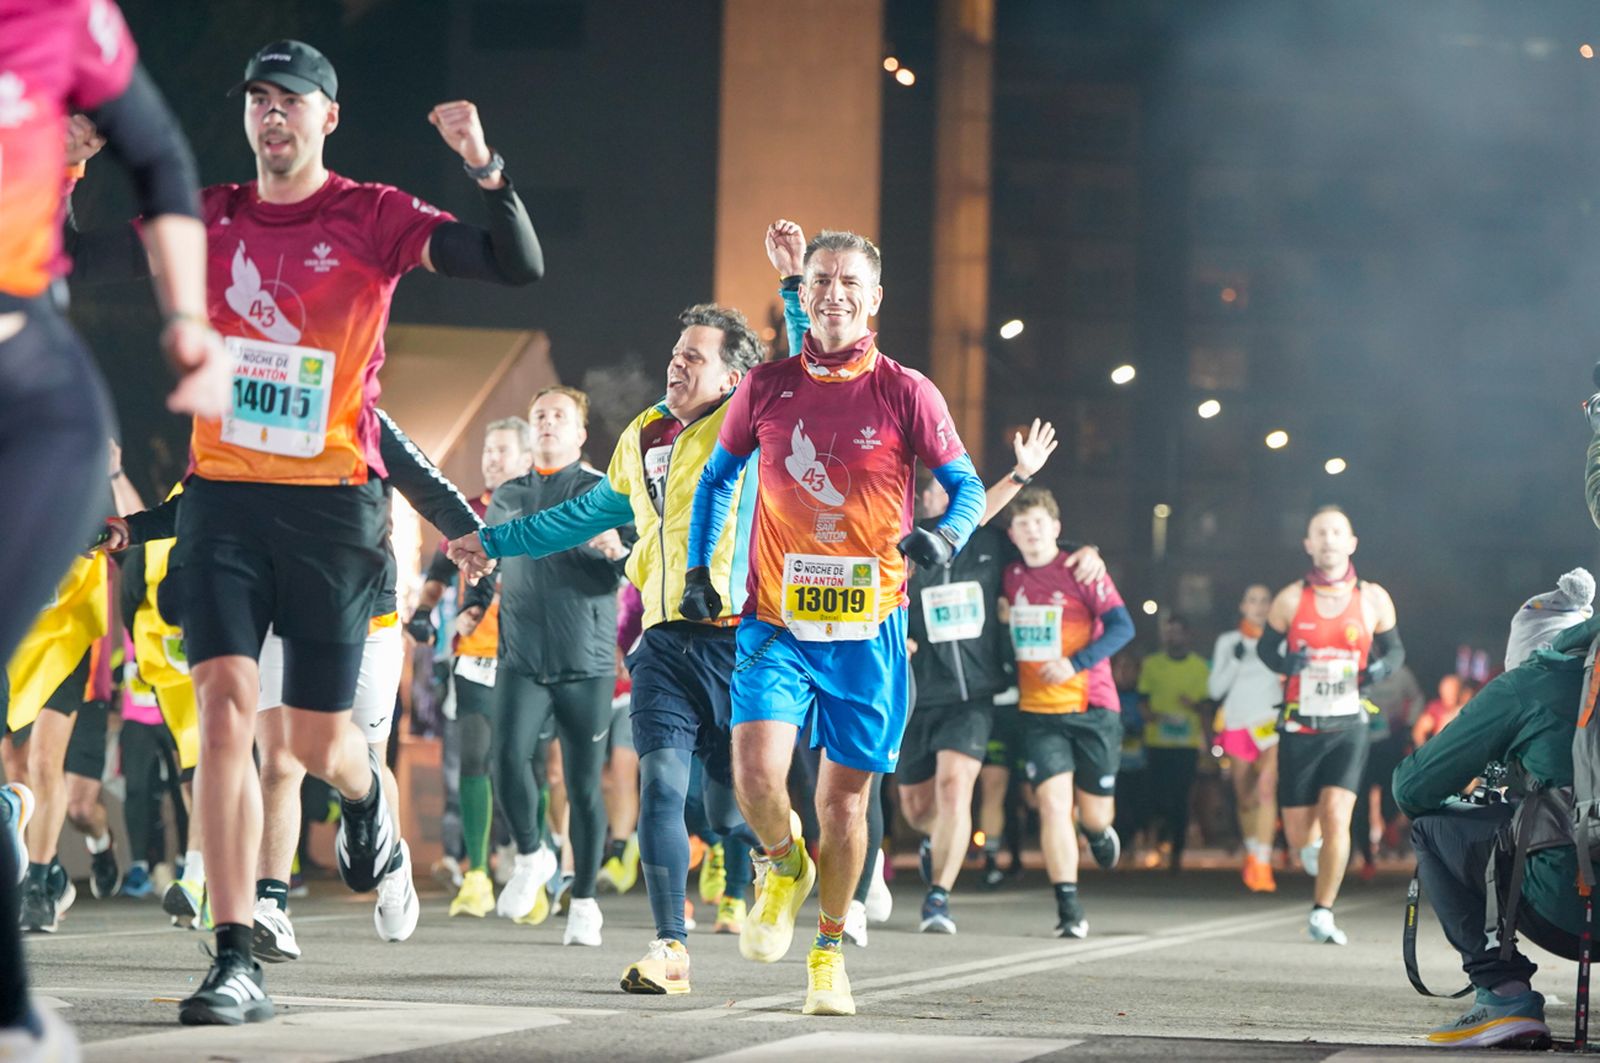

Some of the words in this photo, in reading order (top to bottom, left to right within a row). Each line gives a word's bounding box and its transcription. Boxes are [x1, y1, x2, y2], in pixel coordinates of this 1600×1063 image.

[249, 300, 275, 328] 43
[243, 350, 273, 365] NOCHE
[275, 356, 289, 368] DE
[233, 377, 312, 419] 14015
[801, 468, 826, 492] 43
[815, 523, 837, 532] SAN
[793, 575, 811, 584] SAN
[812, 575, 845, 587] ANTÓN
[804, 565, 832, 576] NOCHE
[833, 567, 845, 576] DE
[794, 586, 866, 614] 13019
